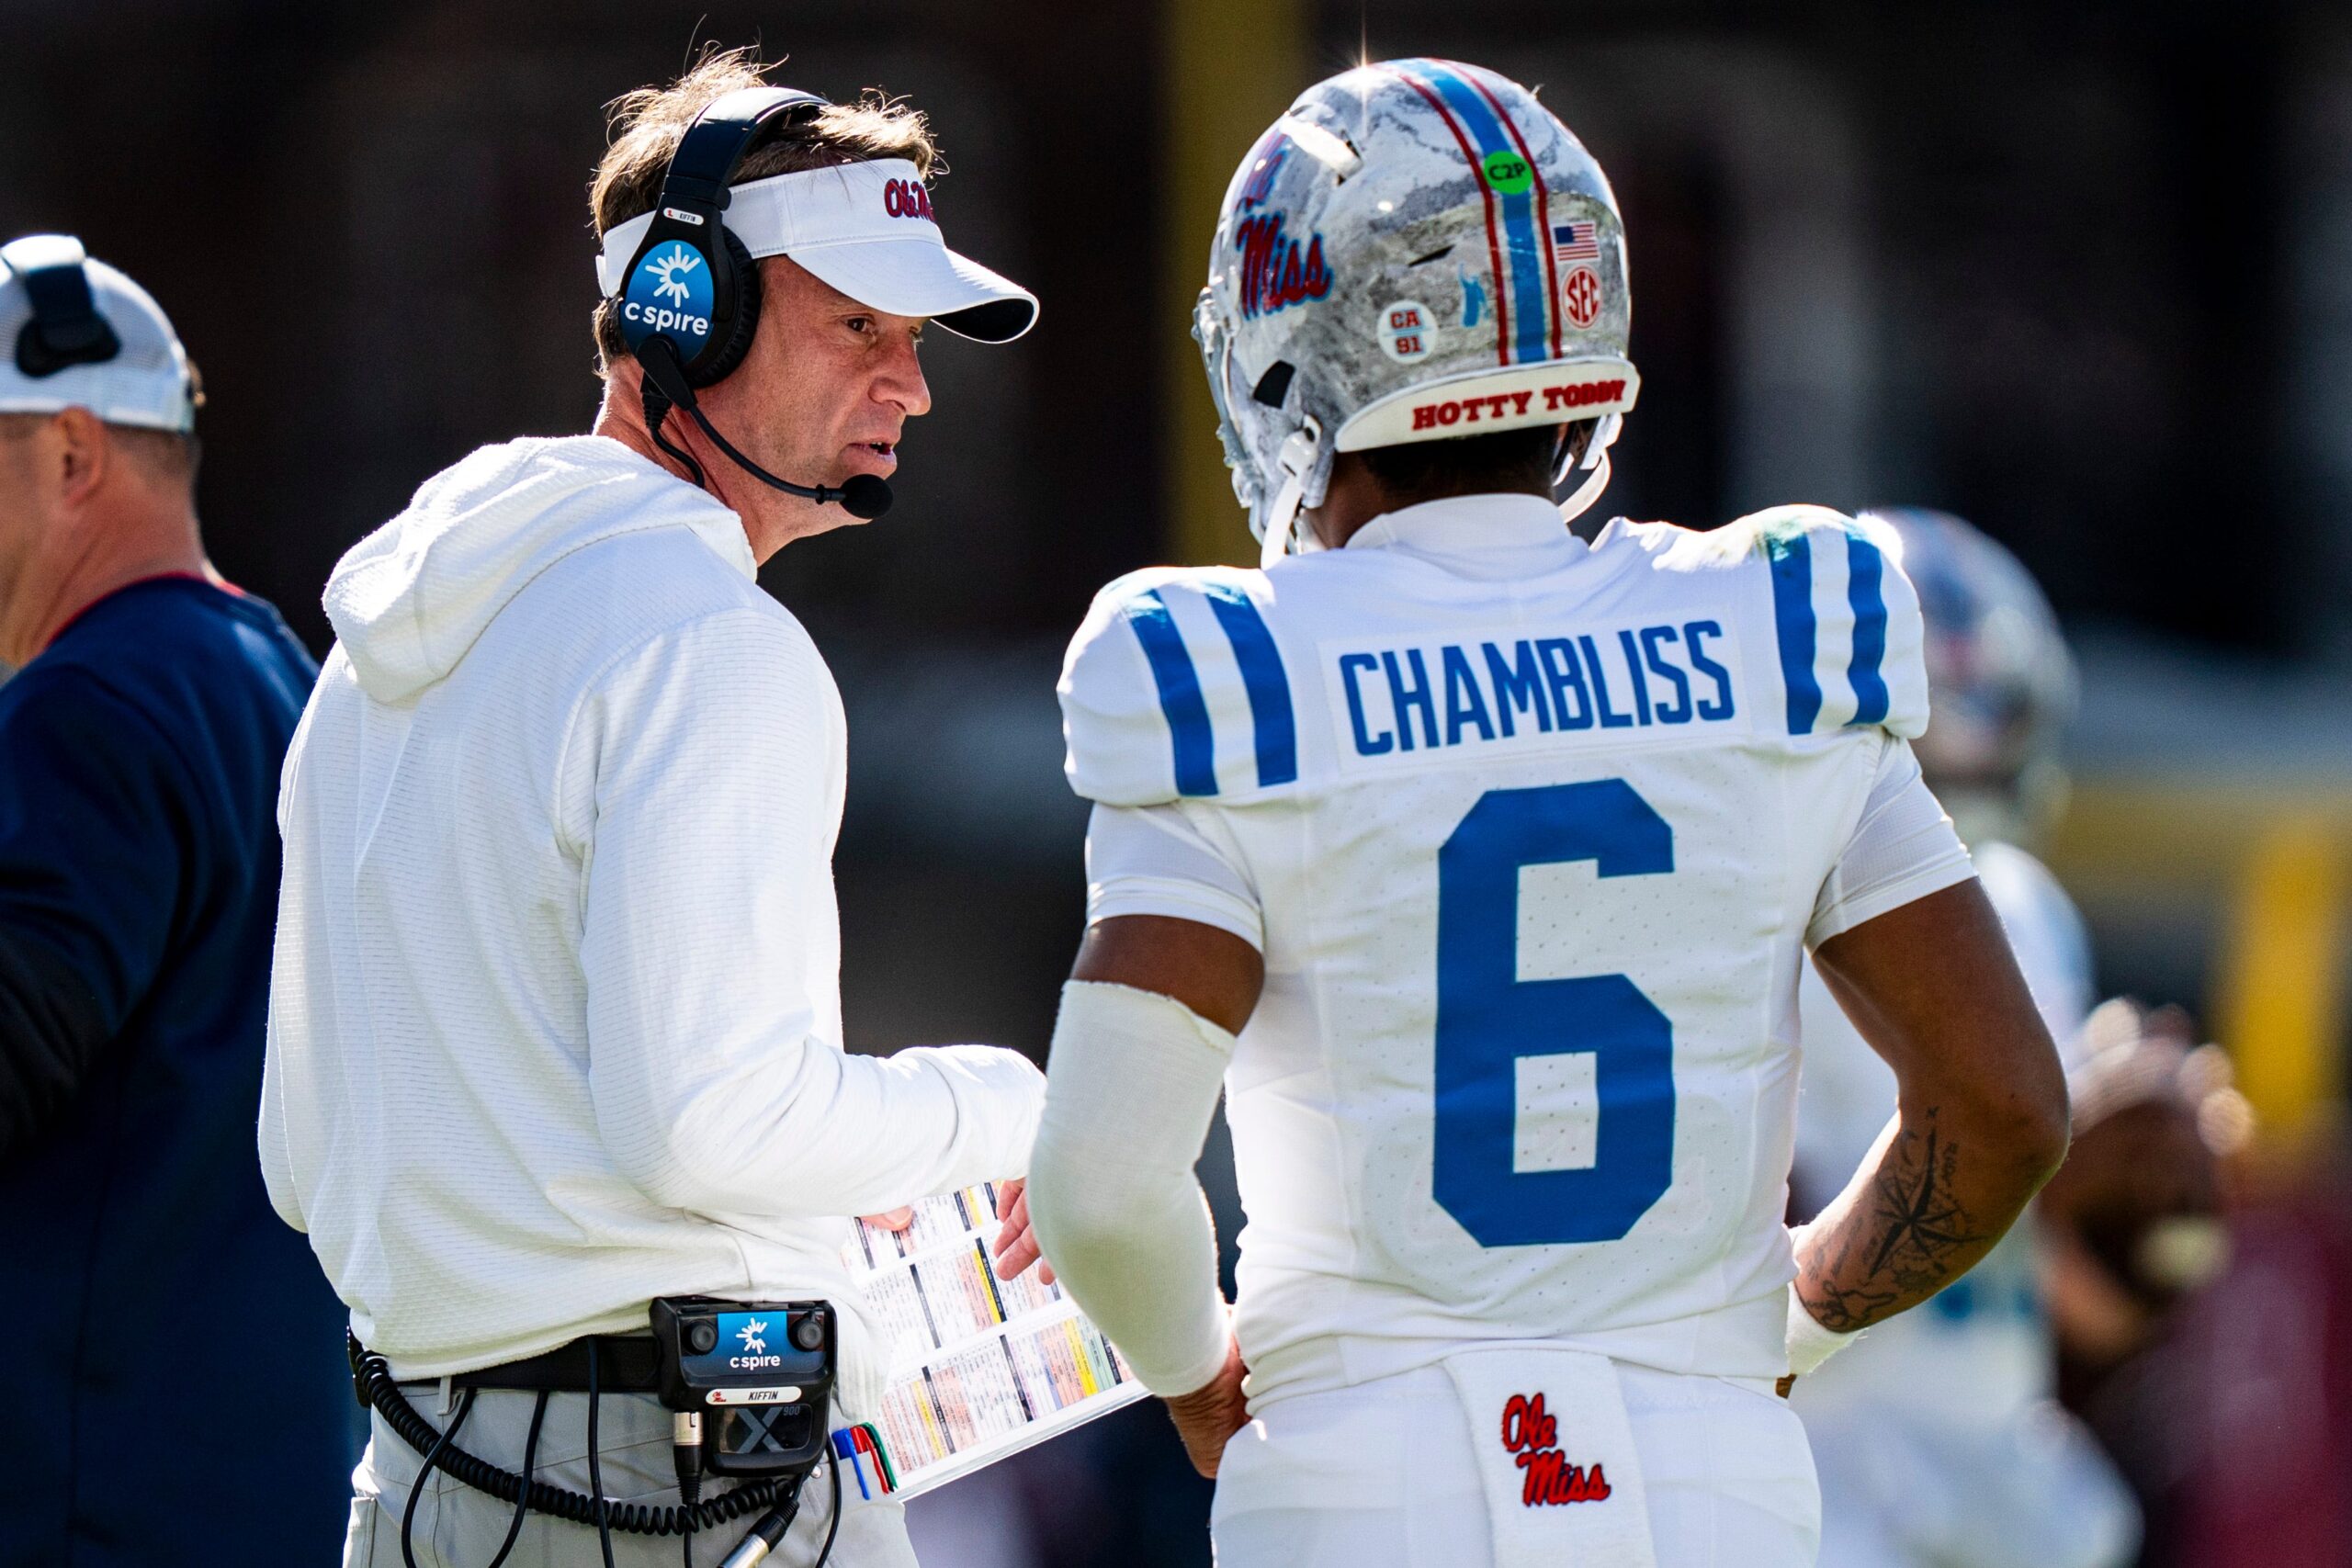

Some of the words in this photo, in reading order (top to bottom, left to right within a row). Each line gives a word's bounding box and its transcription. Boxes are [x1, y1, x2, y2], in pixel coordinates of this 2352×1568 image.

[1488, 163, 1526, 181] C2P
[1236, 211, 1334, 320] Miss
[642, 306, 708, 335] spire
[1391, 309, 1422, 330] CA
[1566, 271, 1599, 322] SEC
[1396, 335, 1425, 355] 91
[1412, 390, 1532, 431] HOTTY
[1543, 379, 1625, 411] TODDY
[1339, 619, 1734, 756] CHAMBLISS
[1431, 777, 1675, 1248] 6
[741, 1355, 781, 1371] spire
[749, 1392, 778, 1401] KIFFIN
[1501, 1392, 1557, 1453] Ole
[1515, 1449, 1611, 1507] Miss
